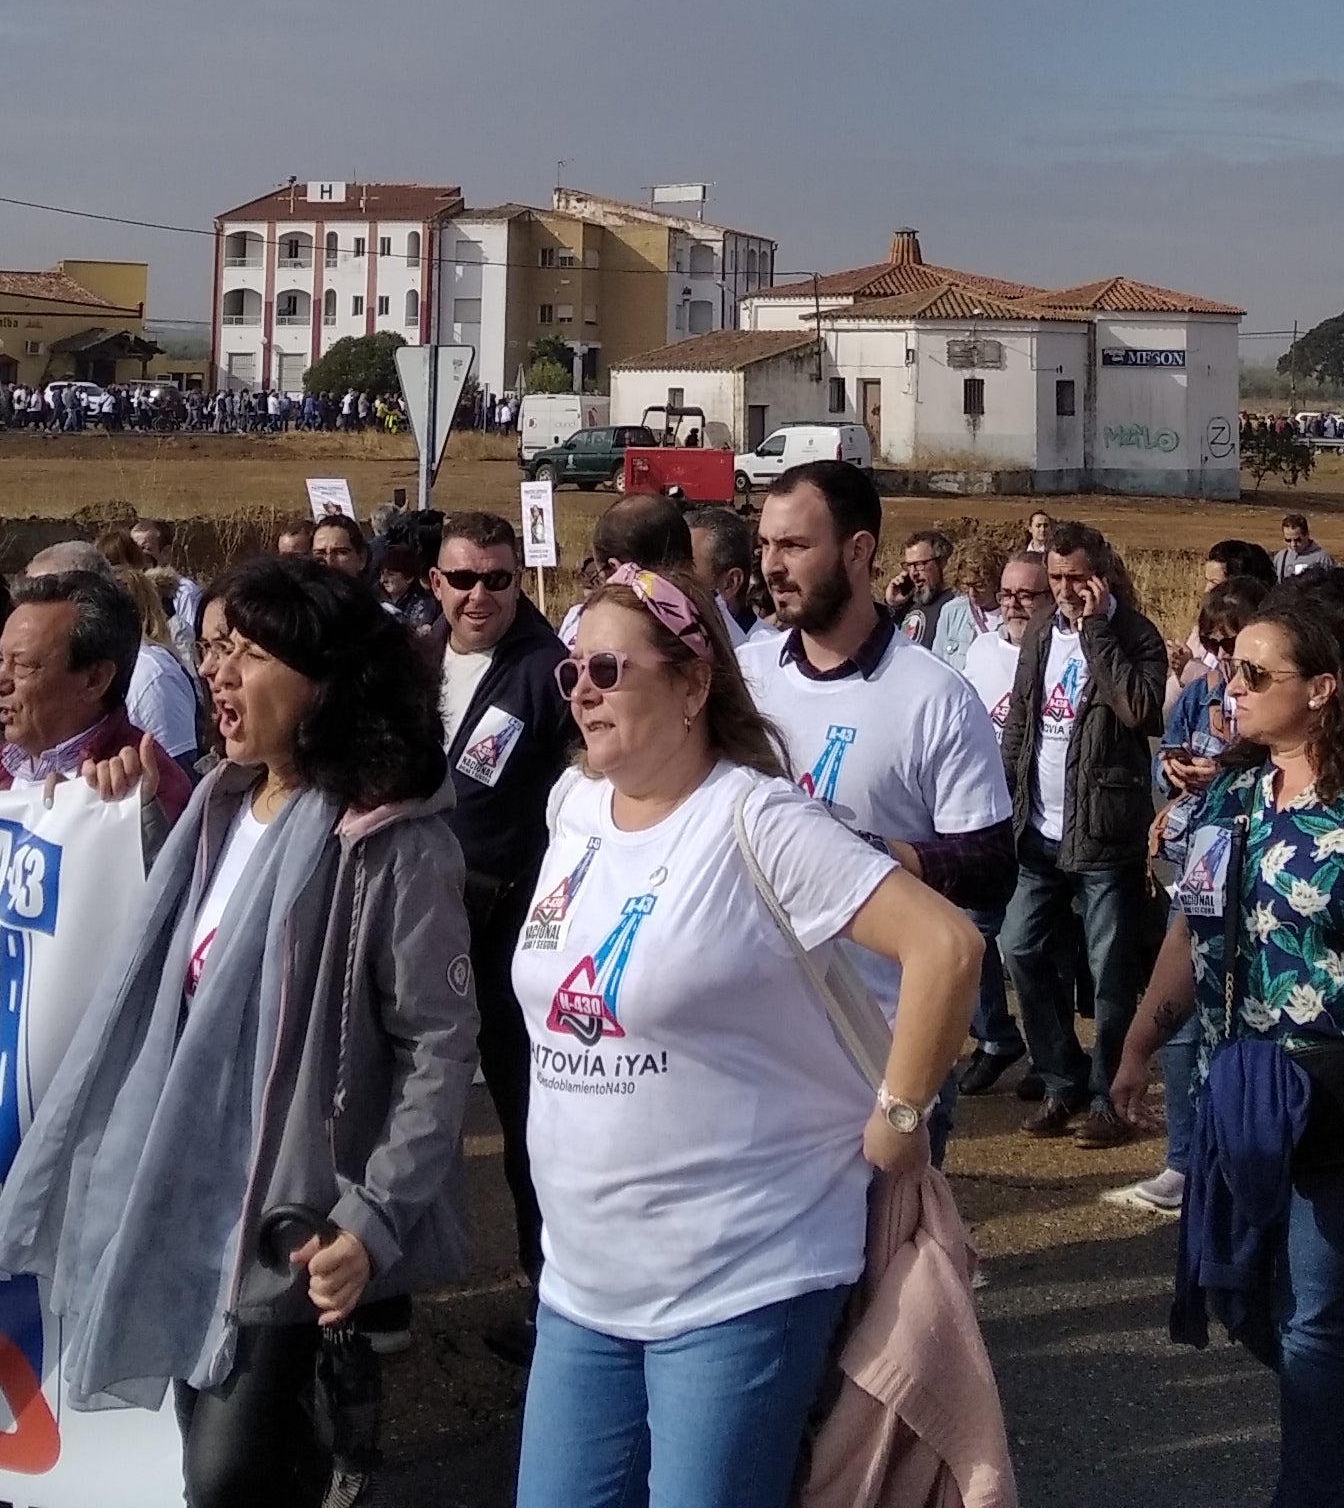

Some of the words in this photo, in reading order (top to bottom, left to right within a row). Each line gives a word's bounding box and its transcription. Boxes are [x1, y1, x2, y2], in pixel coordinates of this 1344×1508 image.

[320, 184, 333, 200] H
[828, 726, 854, 742] A-43
[624, 896, 655, 915] A-43
[559, 992, 601, 1016] N-430
[614, 1050, 668, 1077] ¡YA!
